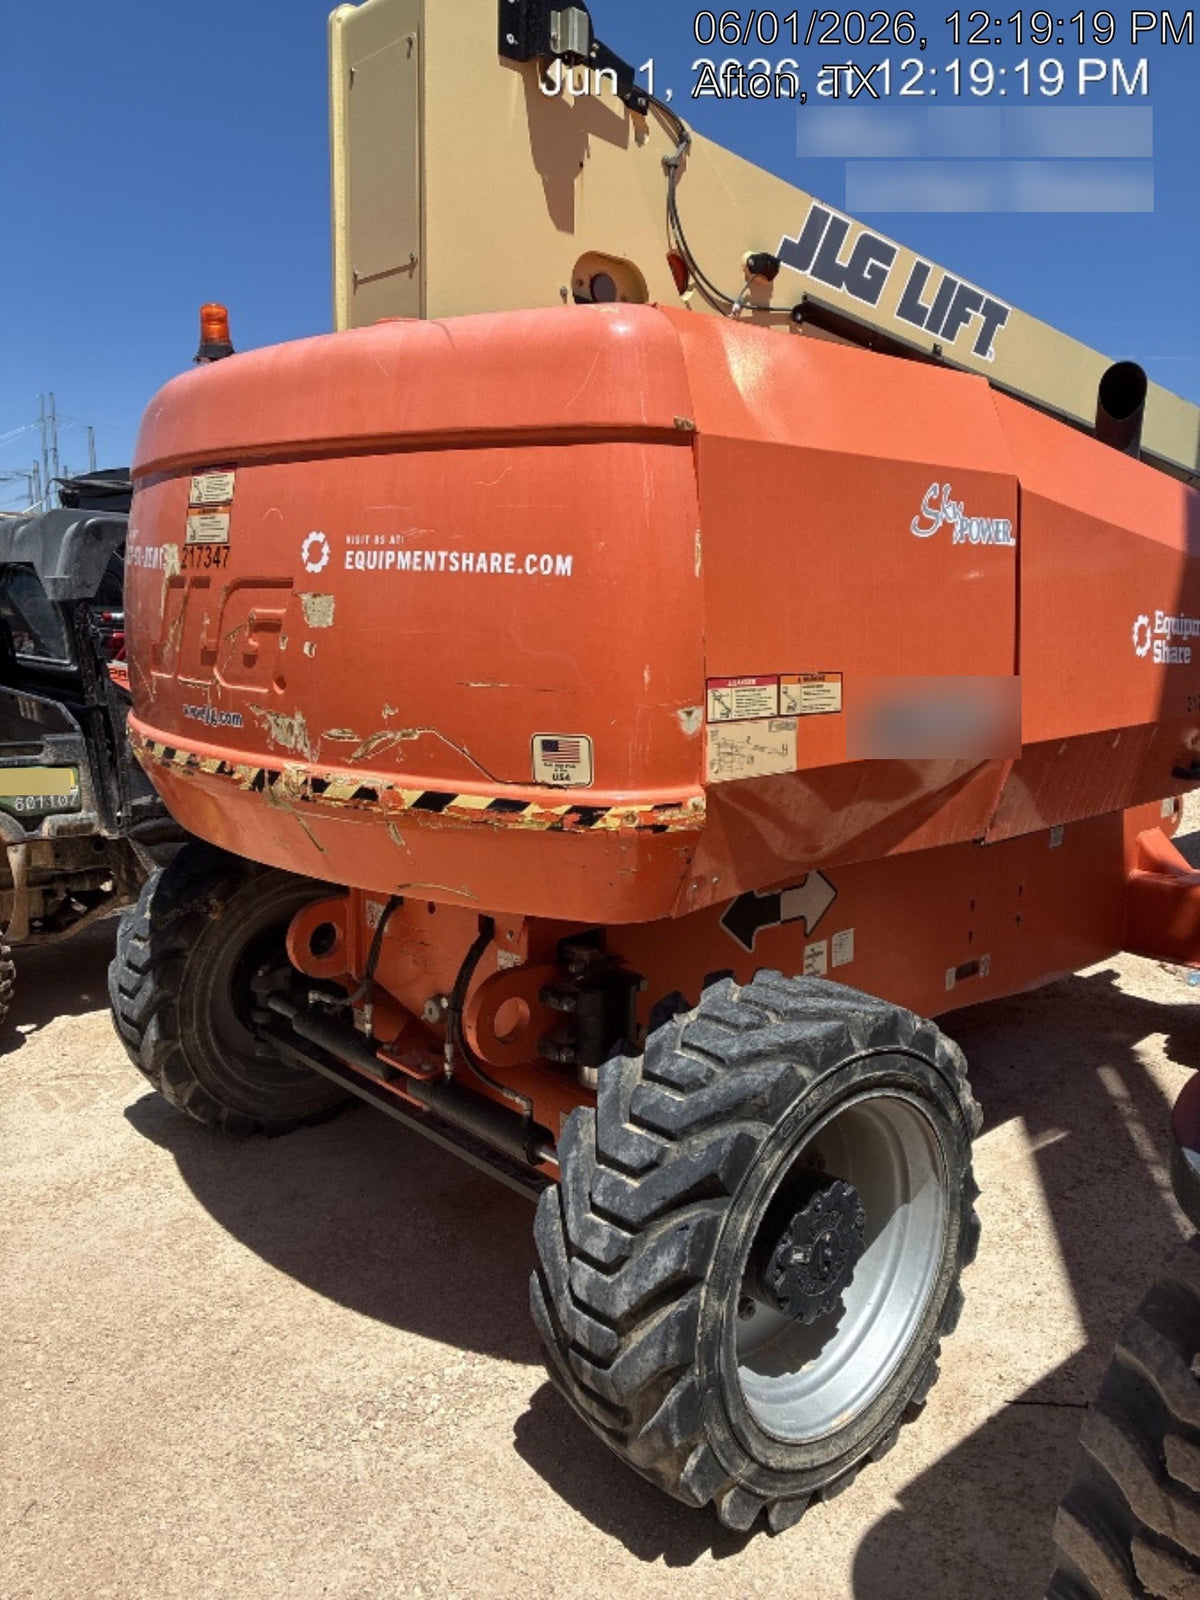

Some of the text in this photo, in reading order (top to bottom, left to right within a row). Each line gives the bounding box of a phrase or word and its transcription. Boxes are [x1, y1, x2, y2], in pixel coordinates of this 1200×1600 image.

[775, 201, 1013, 361] JLG LIFT
[181, 545, 231, 568] 217347
[344, 549, 574, 577] EQUIPMENTSHARE.COM
[1153, 639, 1192, 664] Share
